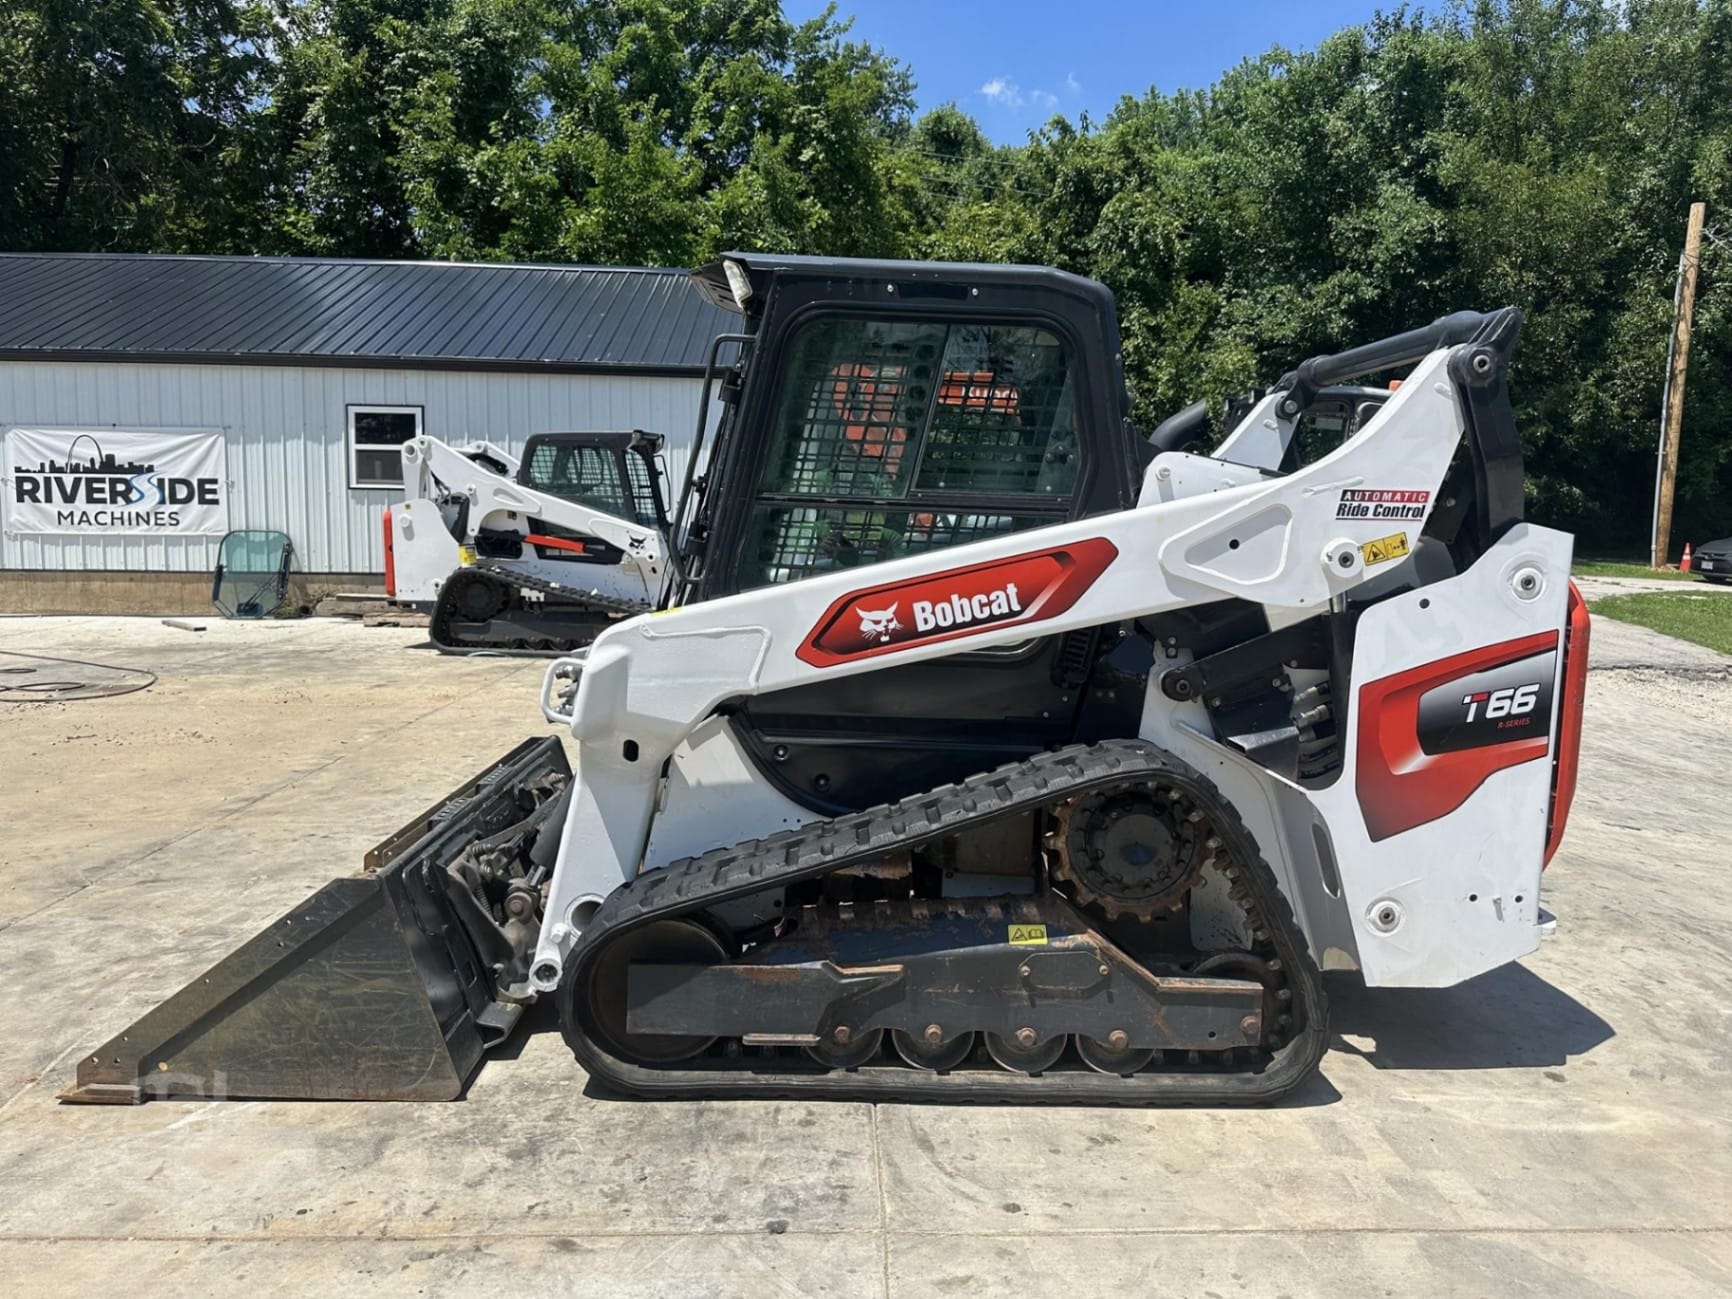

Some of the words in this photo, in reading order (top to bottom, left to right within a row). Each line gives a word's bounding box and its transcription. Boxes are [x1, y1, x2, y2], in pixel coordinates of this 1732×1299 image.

[15, 474, 220, 506] RIVERSIDE
[1343, 491, 1426, 502] AUTOMATIC
[57, 510, 180, 526] MACHINES
[1336, 503, 1369, 517] Ride
[1372, 503, 1426, 518] Control
[912, 583, 1022, 632] Bobcat
[1463, 683, 1540, 723] T66
[1497, 717, 1531, 729] R-SERIES
